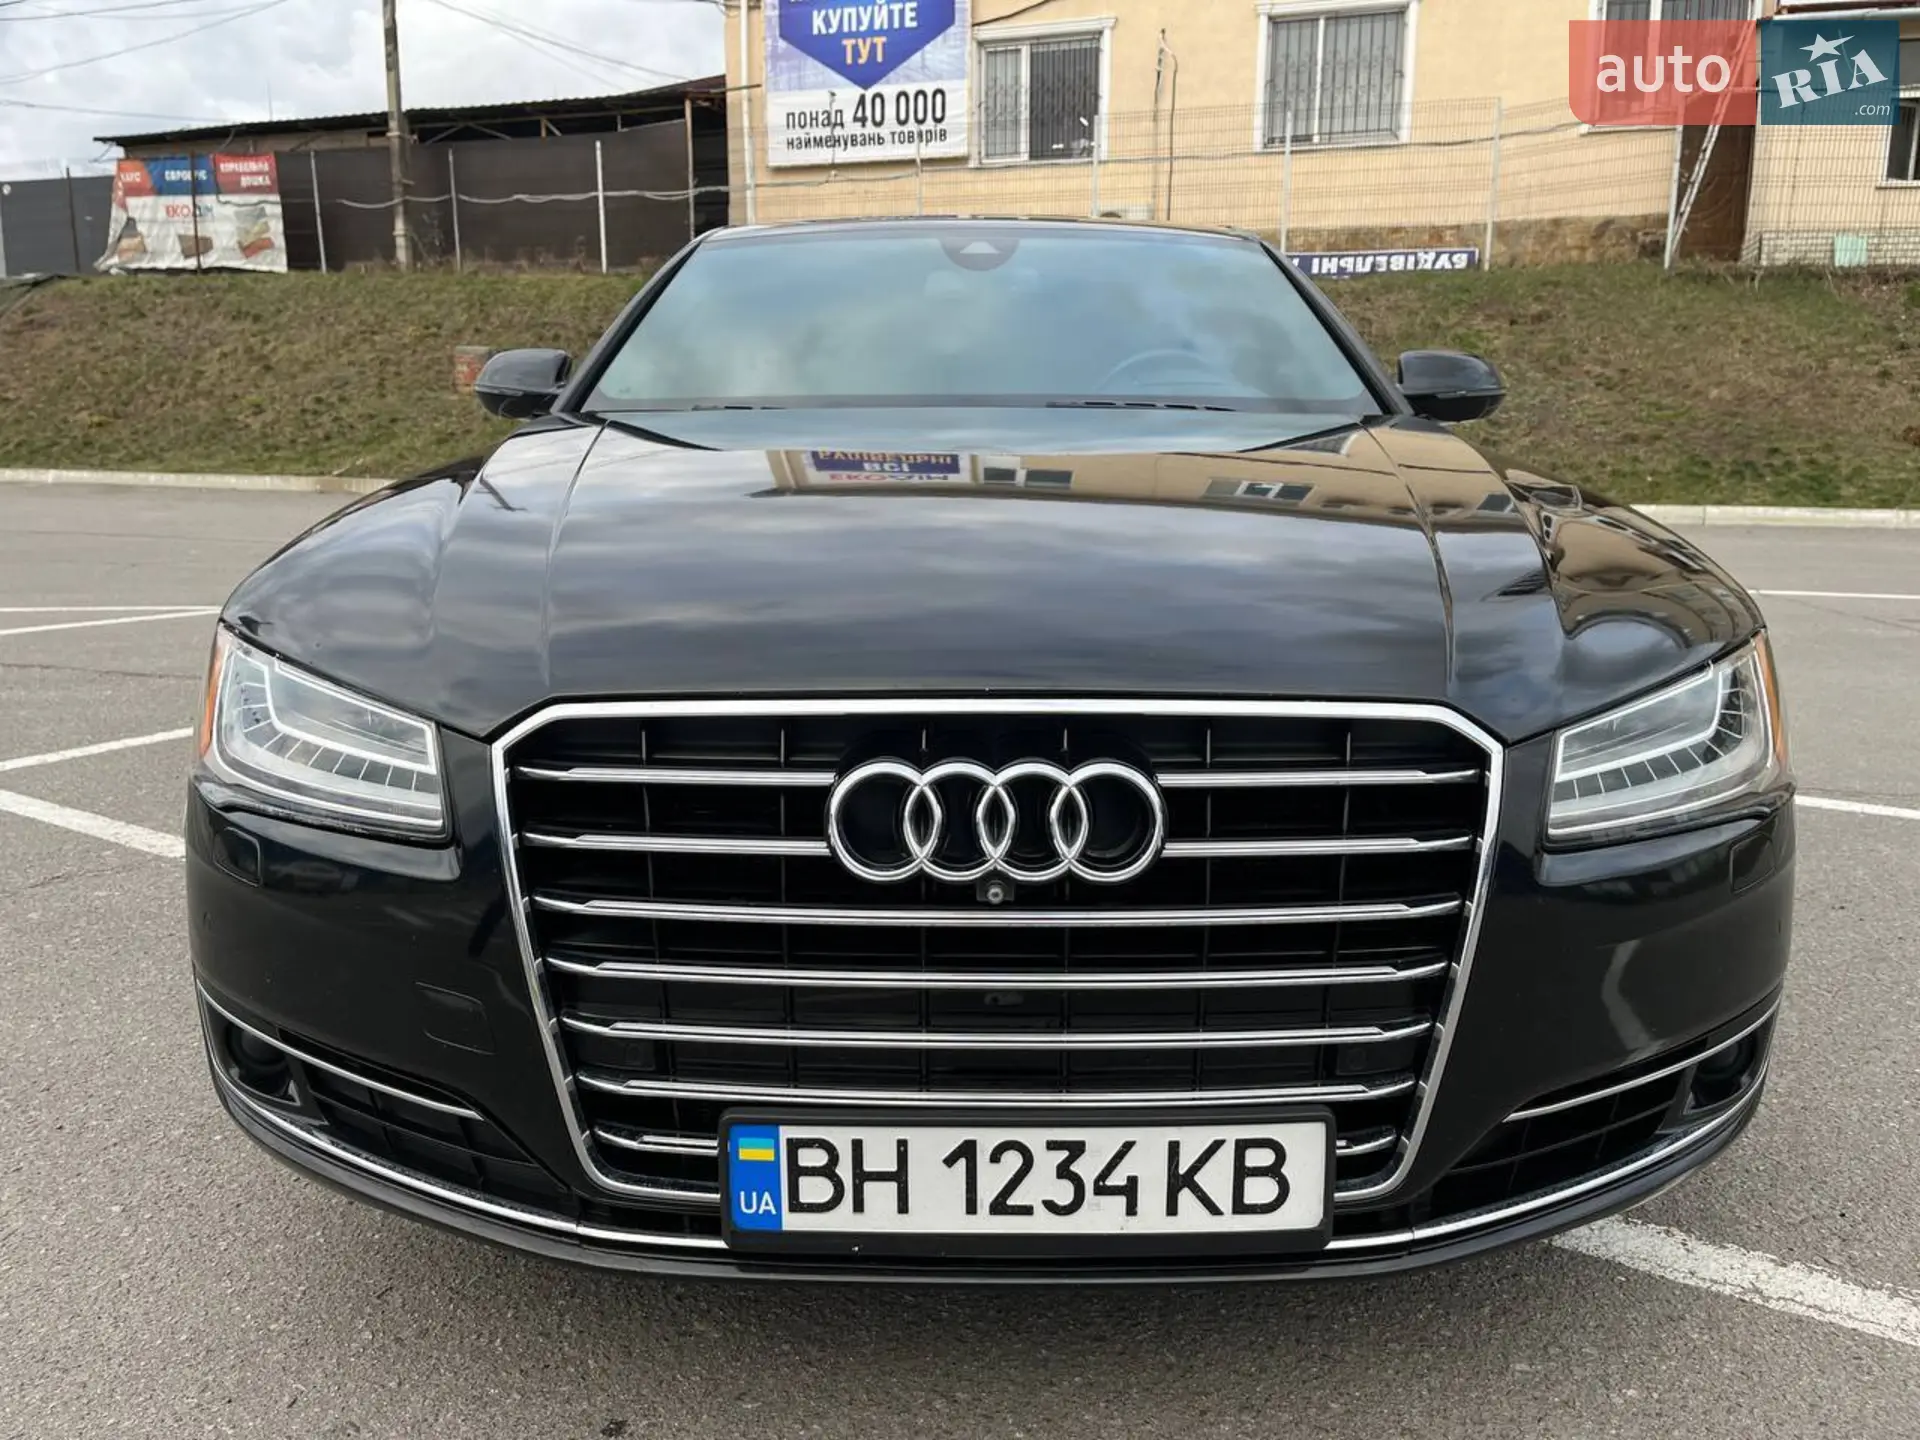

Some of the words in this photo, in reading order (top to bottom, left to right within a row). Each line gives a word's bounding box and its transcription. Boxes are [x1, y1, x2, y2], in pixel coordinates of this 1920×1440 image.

[812, 1, 918, 35] КУПУЙТЕ
[841, 36, 887, 65] ТУТ
[786, 108, 845, 130] понад
[852, 91, 885, 128] 40
[896, 88, 946, 125] 000
[786, 131, 885, 152] найменувань
[785, 1137, 910, 1215] BH
[942, 1138, 1138, 1217] 1234
[1166, 1137, 1291, 1217] KB
[740, 1191, 777, 1216] UA
